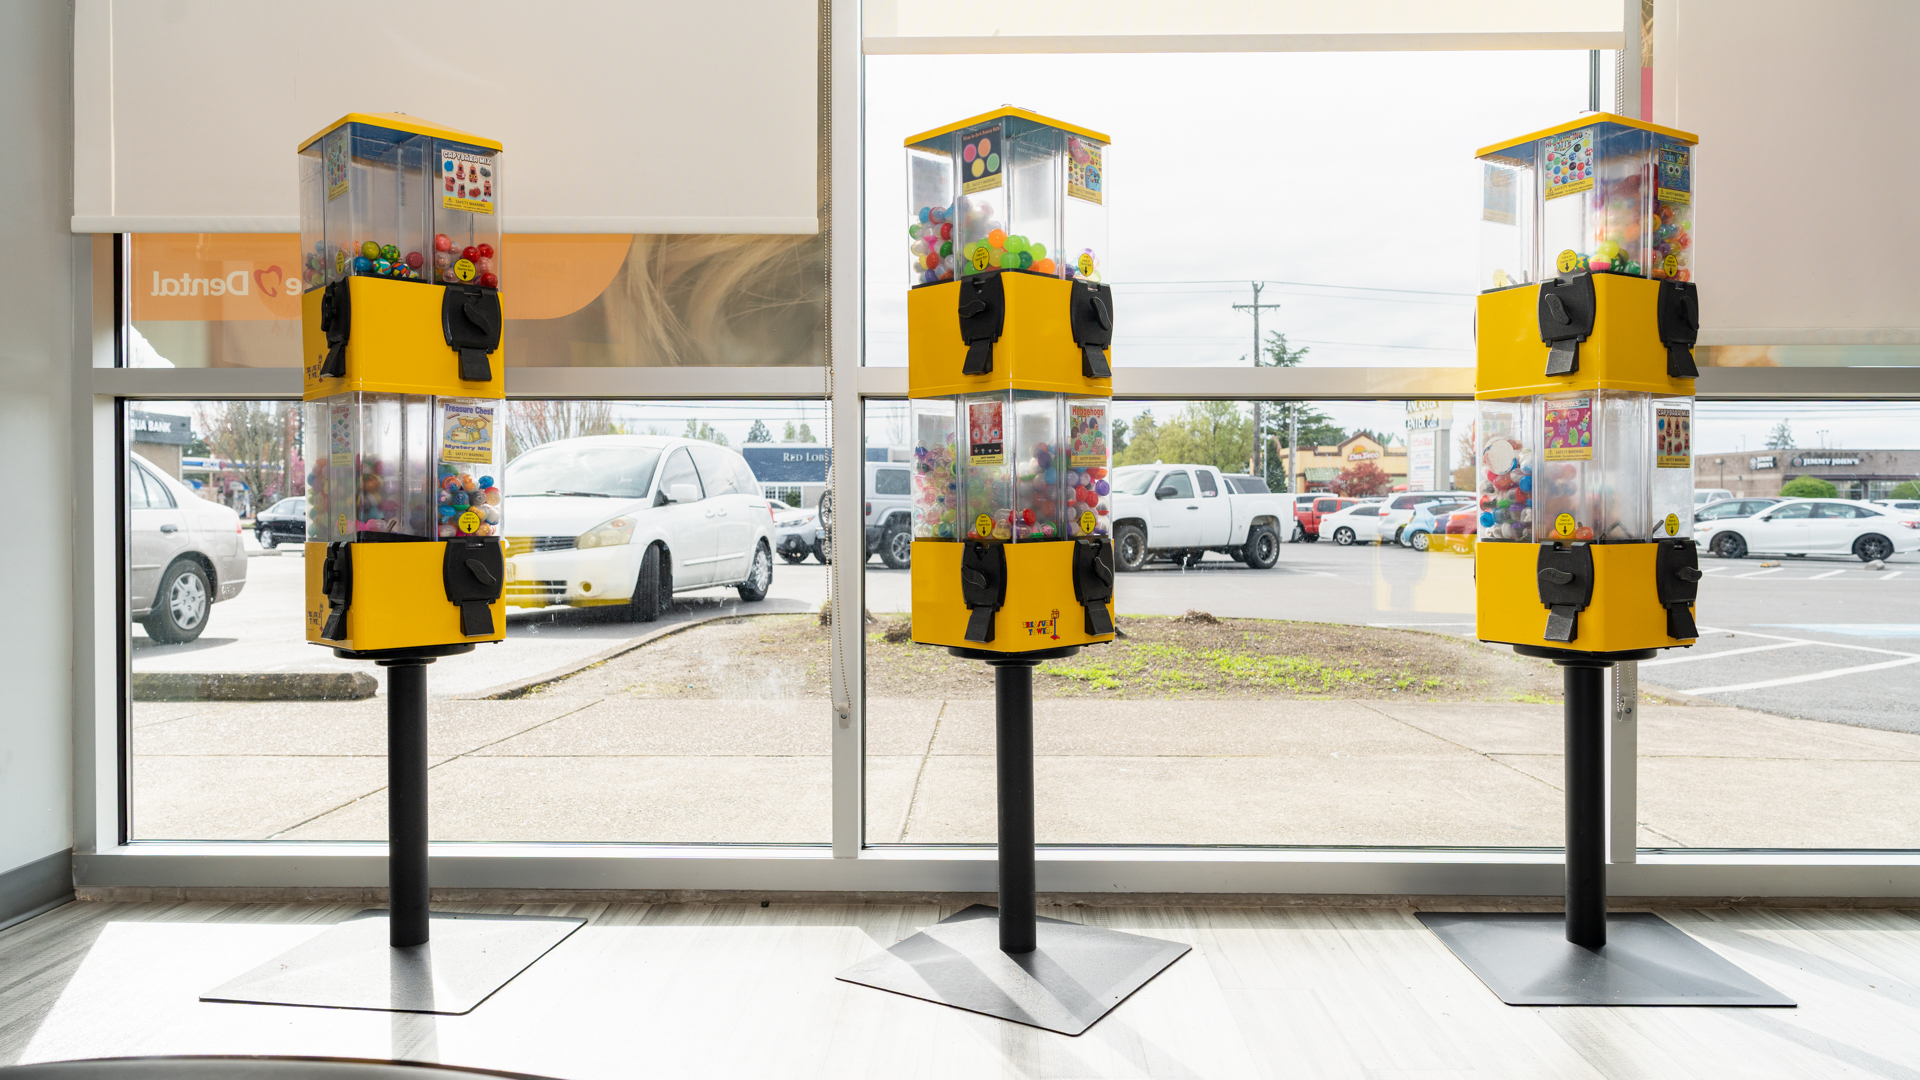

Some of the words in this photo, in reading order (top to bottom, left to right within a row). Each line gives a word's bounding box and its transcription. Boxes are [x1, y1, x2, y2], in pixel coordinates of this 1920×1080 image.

[443, 151, 478, 163] CAPYBARA
[1567, 180, 1585, 188] WARNING
[445, 404, 474, 414] Treasure
[475, 407, 494, 415] Chest
[1072, 406, 1104, 418] Hedgehogs
[1657, 409, 1681, 417] CAPYBARA
[148, 420, 171, 433] BANK
[783, 452, 803, 462] RED
[1804, 458, 1831, 466] JIMMY
[1832, 458, 1860, 466] JOHN'S
